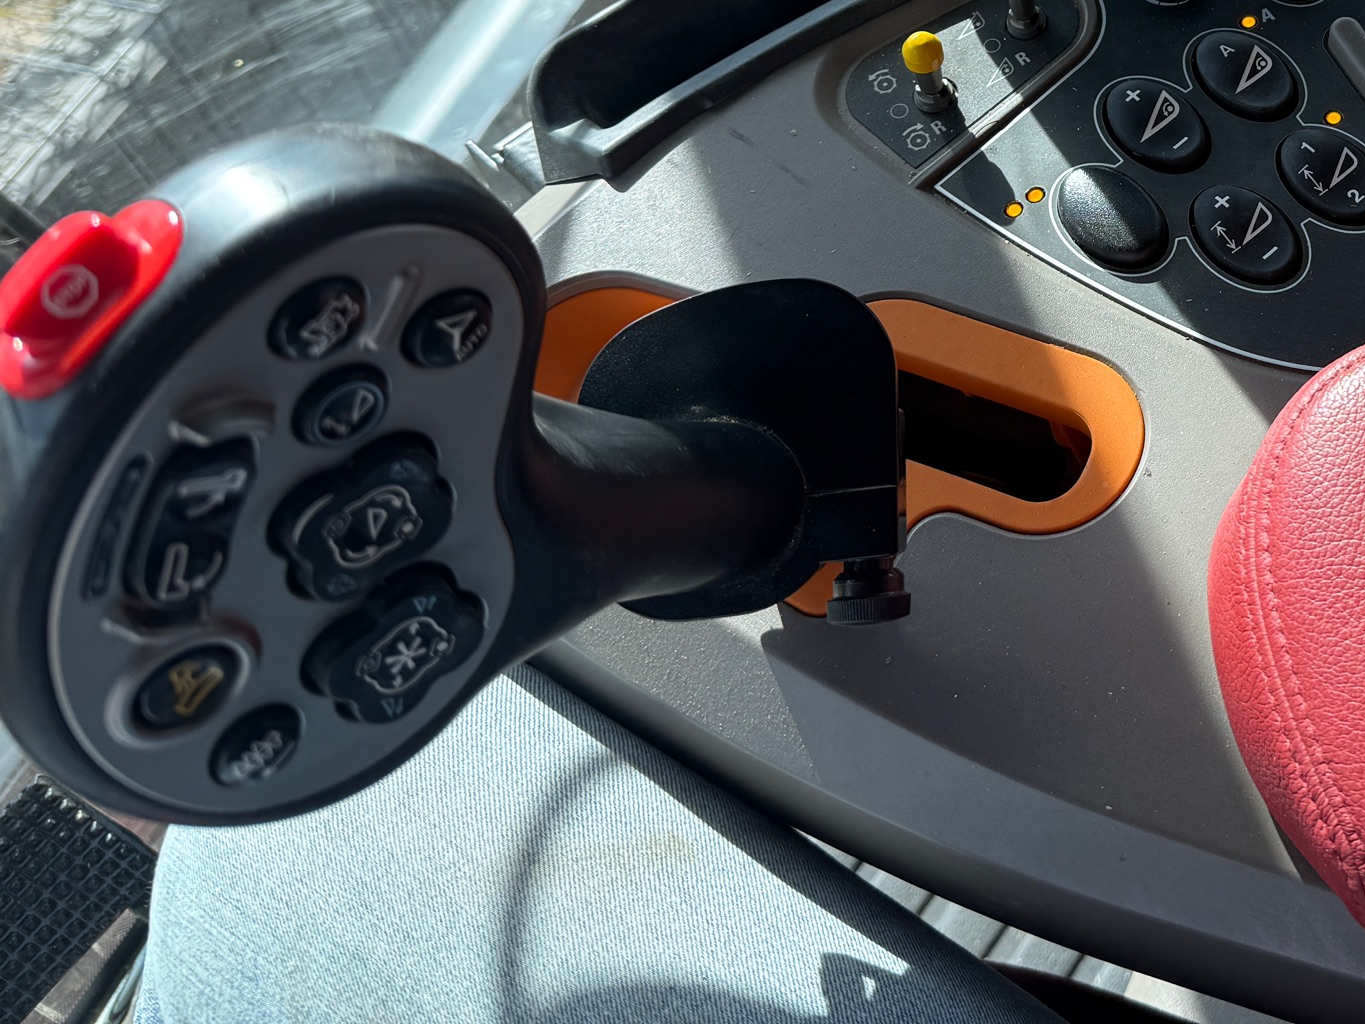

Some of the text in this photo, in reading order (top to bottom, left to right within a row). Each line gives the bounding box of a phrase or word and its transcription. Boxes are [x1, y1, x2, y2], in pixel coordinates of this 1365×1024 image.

[1261, 8, 1276, 22] A
[1219, 44, 1235, 58] A
[1014, 51, 1031, 66] R
[930, 120, 947, 135] R
[1300, 141, 1316, 153] 1
[1347, 189, 1365, 204] 2
